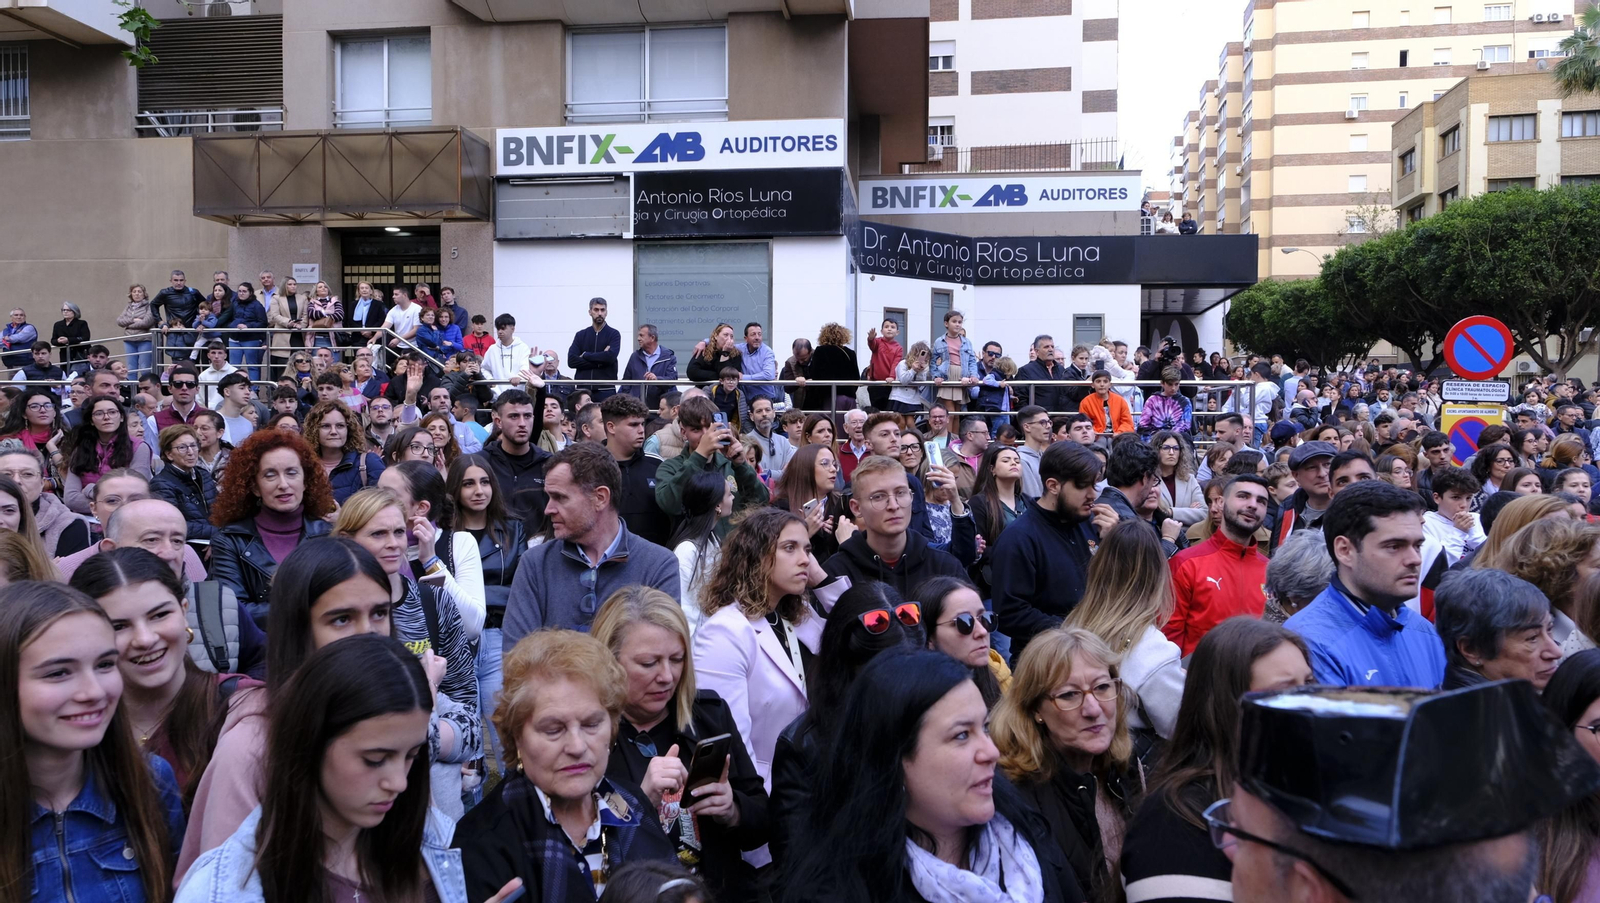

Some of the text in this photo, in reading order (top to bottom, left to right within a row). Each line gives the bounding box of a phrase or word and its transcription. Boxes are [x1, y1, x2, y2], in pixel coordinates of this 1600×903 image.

[503, 134, 617, 166] BNFIX
[719, 134, 838, 154] AUDITORES
[636, 187, 793, 205] Antonio Ríos Luna
[871, 185, 959, 209] BNFIX
[1039, 187, 1128, 202] AUDITORES
[653, 212, 661, 223] y
[664, 208, 709, 224] Cirugía
[712, 206, 787, 222] Ortopédica
[451, 246, 459, 259] 5
[864, 227, 1100, 263] Dr. Antonio Ríos Luna
[914, 262, 922, 275] y
[927, 259, 973, 282] Cirugía
[978, 263, 1085, 282] Ortopédica
[675, 280, 711, 288] Deportivas
[710, 305, 740, 313] Corporal
